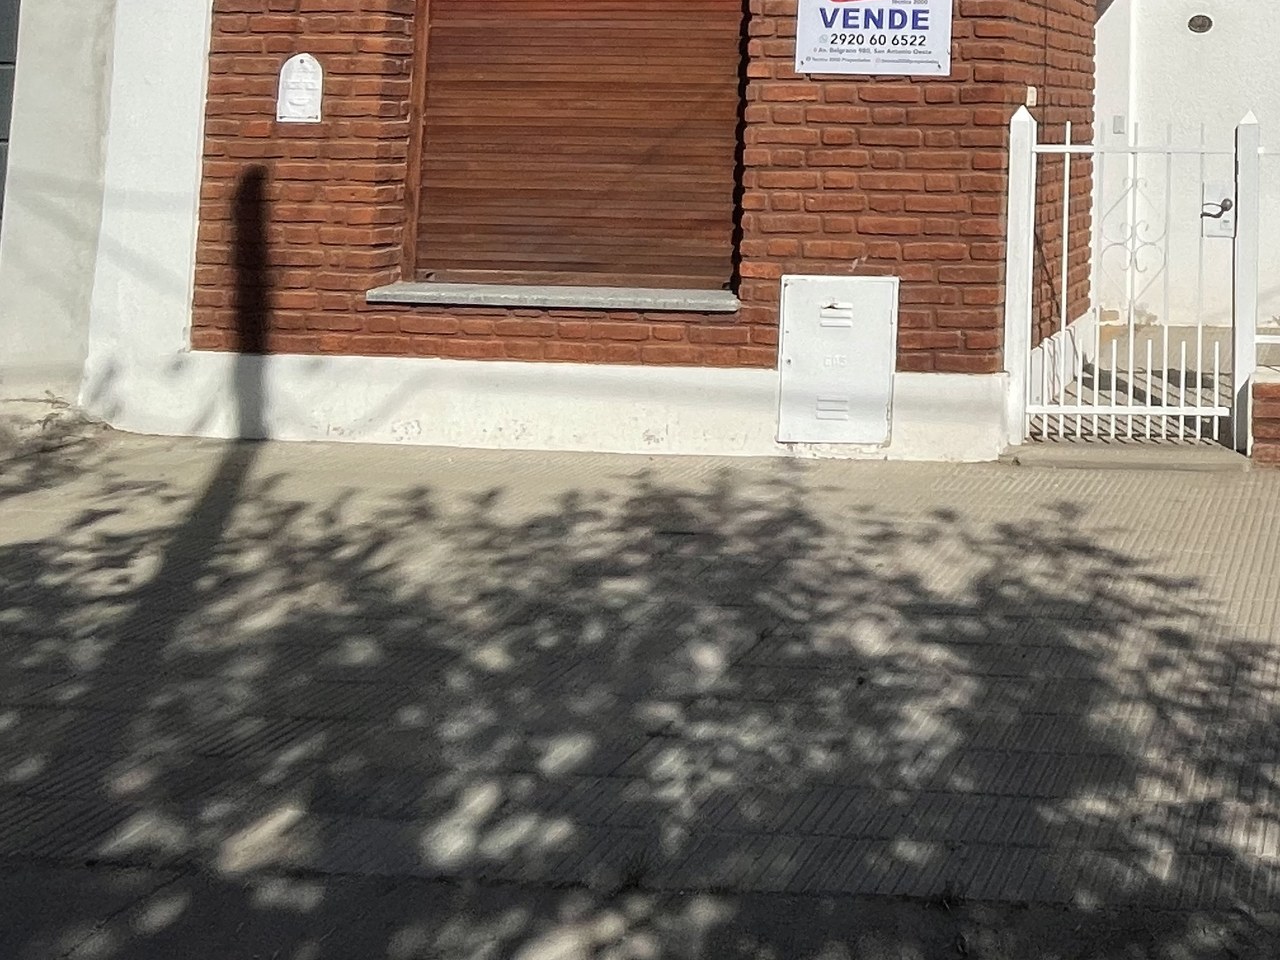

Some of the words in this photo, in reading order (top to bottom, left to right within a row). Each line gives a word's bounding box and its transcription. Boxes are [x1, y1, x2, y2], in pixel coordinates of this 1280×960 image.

[819, 7, 930, 30] VENDE
[830, 33, 865, 46] 2920
[869, 34, 887, 46] 60
[891, 34, 926, 47] 6522
